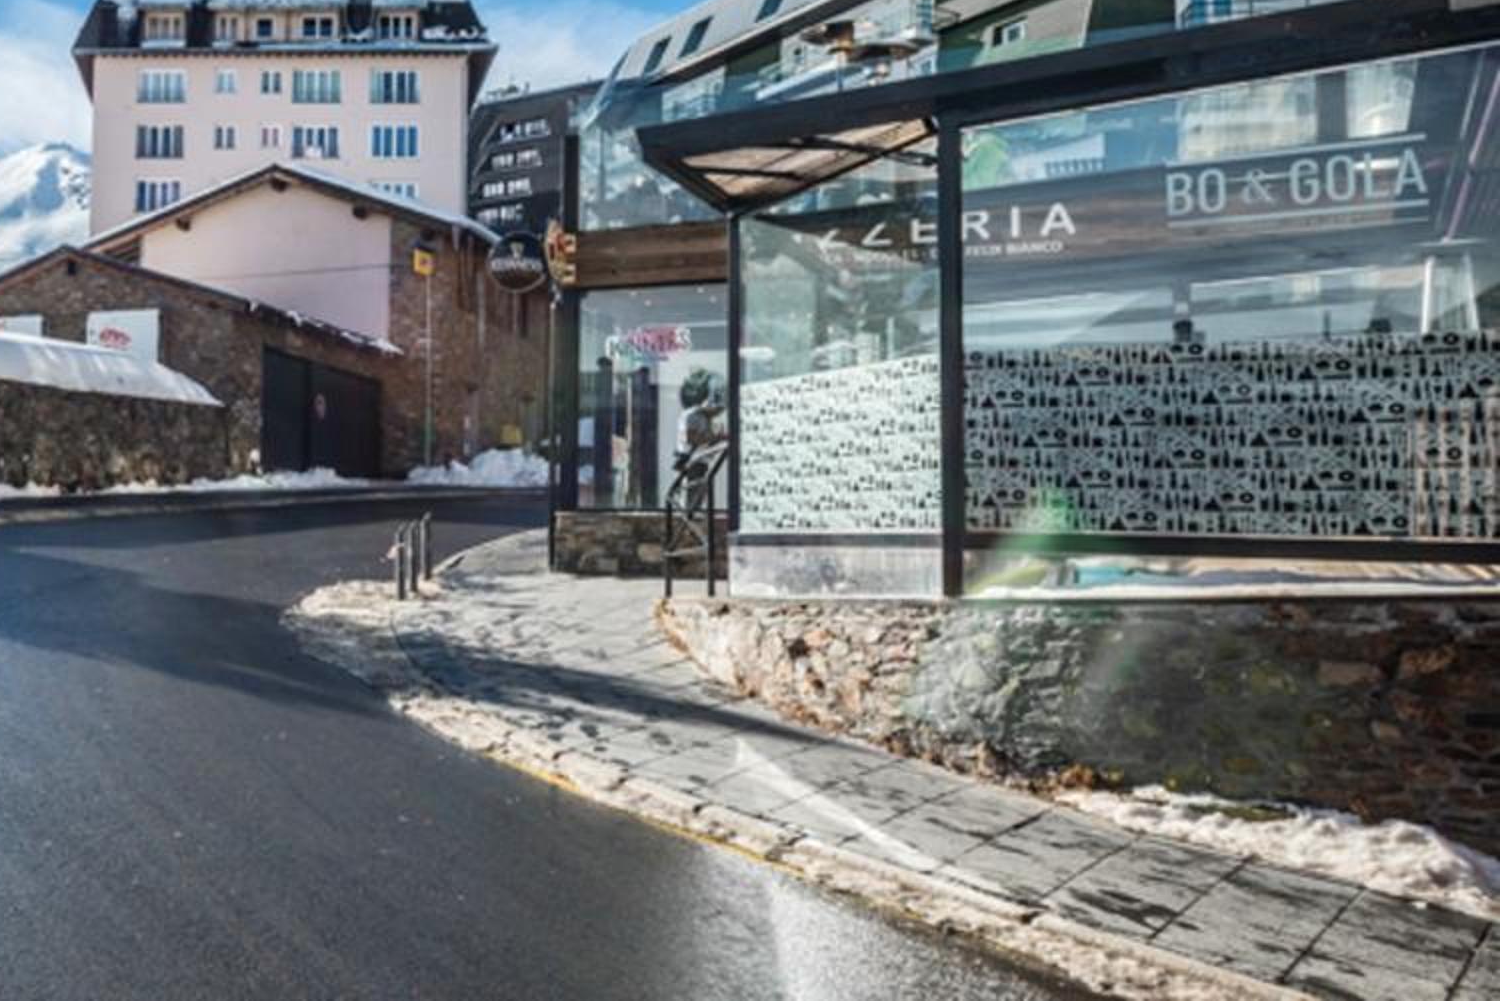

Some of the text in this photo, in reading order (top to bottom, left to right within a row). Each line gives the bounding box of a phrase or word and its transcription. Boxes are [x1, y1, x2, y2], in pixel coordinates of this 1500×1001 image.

[1165, 148, 1428, 216] BO & GOLA
[792, 202, 1077, 248] ZZERIA
